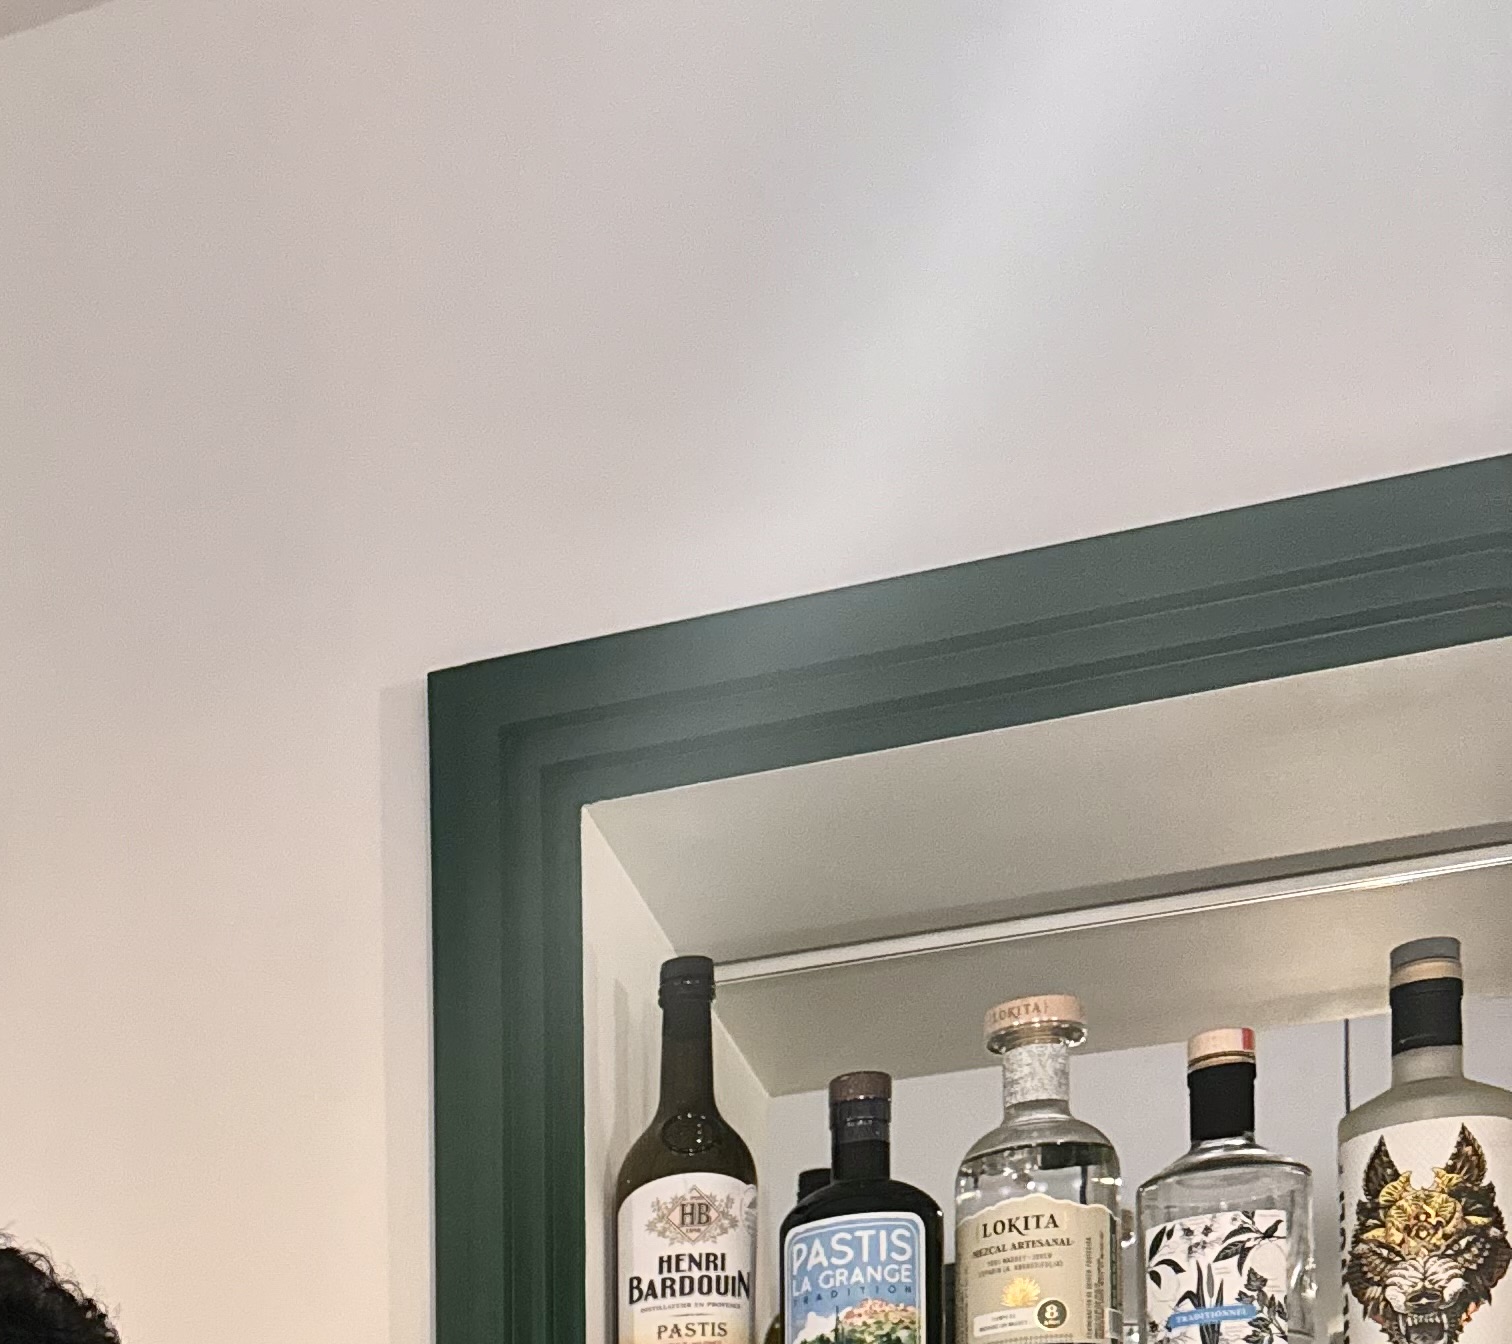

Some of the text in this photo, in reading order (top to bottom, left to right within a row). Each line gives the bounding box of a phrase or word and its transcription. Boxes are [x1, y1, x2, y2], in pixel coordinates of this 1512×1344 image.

[679, 1203, 712, 1227] HB
[982, 1213, 1060, 1239] LOKITA
[658, 1252, 726, 1275] HENRI
[792, 1228, 913, 1276] PASTIS
[628, 1270, 751, 1304] BARDOUIN
[792, 1263, 913, 1297] LA GRANGE
[793, 1286, 912, 1307] TRADITION
[1044, 1303, 1059, 1319] 8
[657, 1321, 728, 1341] PASTIS
